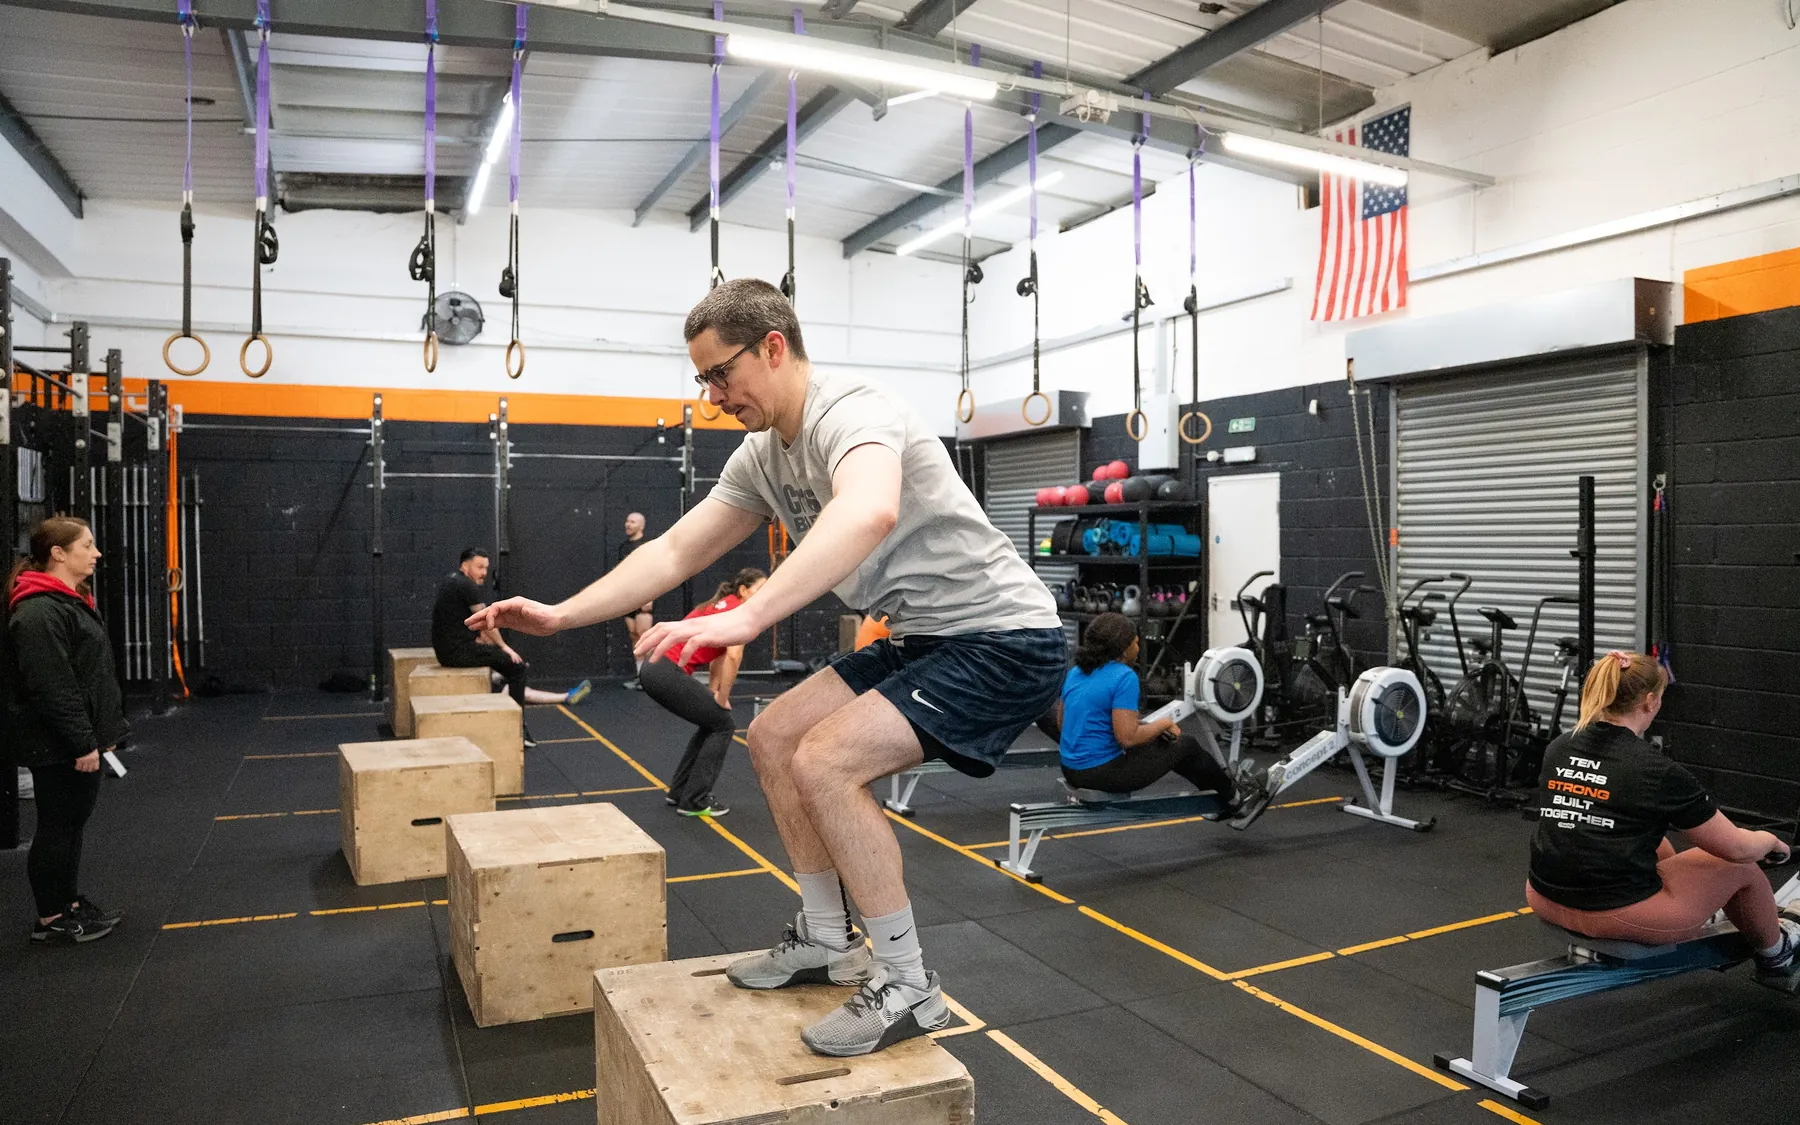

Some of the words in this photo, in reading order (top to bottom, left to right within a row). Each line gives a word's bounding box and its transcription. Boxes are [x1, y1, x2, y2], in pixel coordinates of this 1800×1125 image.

[1569, 756, 1601, 770] TEN
[1555, 767, 1608, 785] YEARS
[1547, 780, 1611, 801] STRONG
[1552, 795, 1594, 811] BUILT
[1540, 807, 1615, 830] TOGETHER
